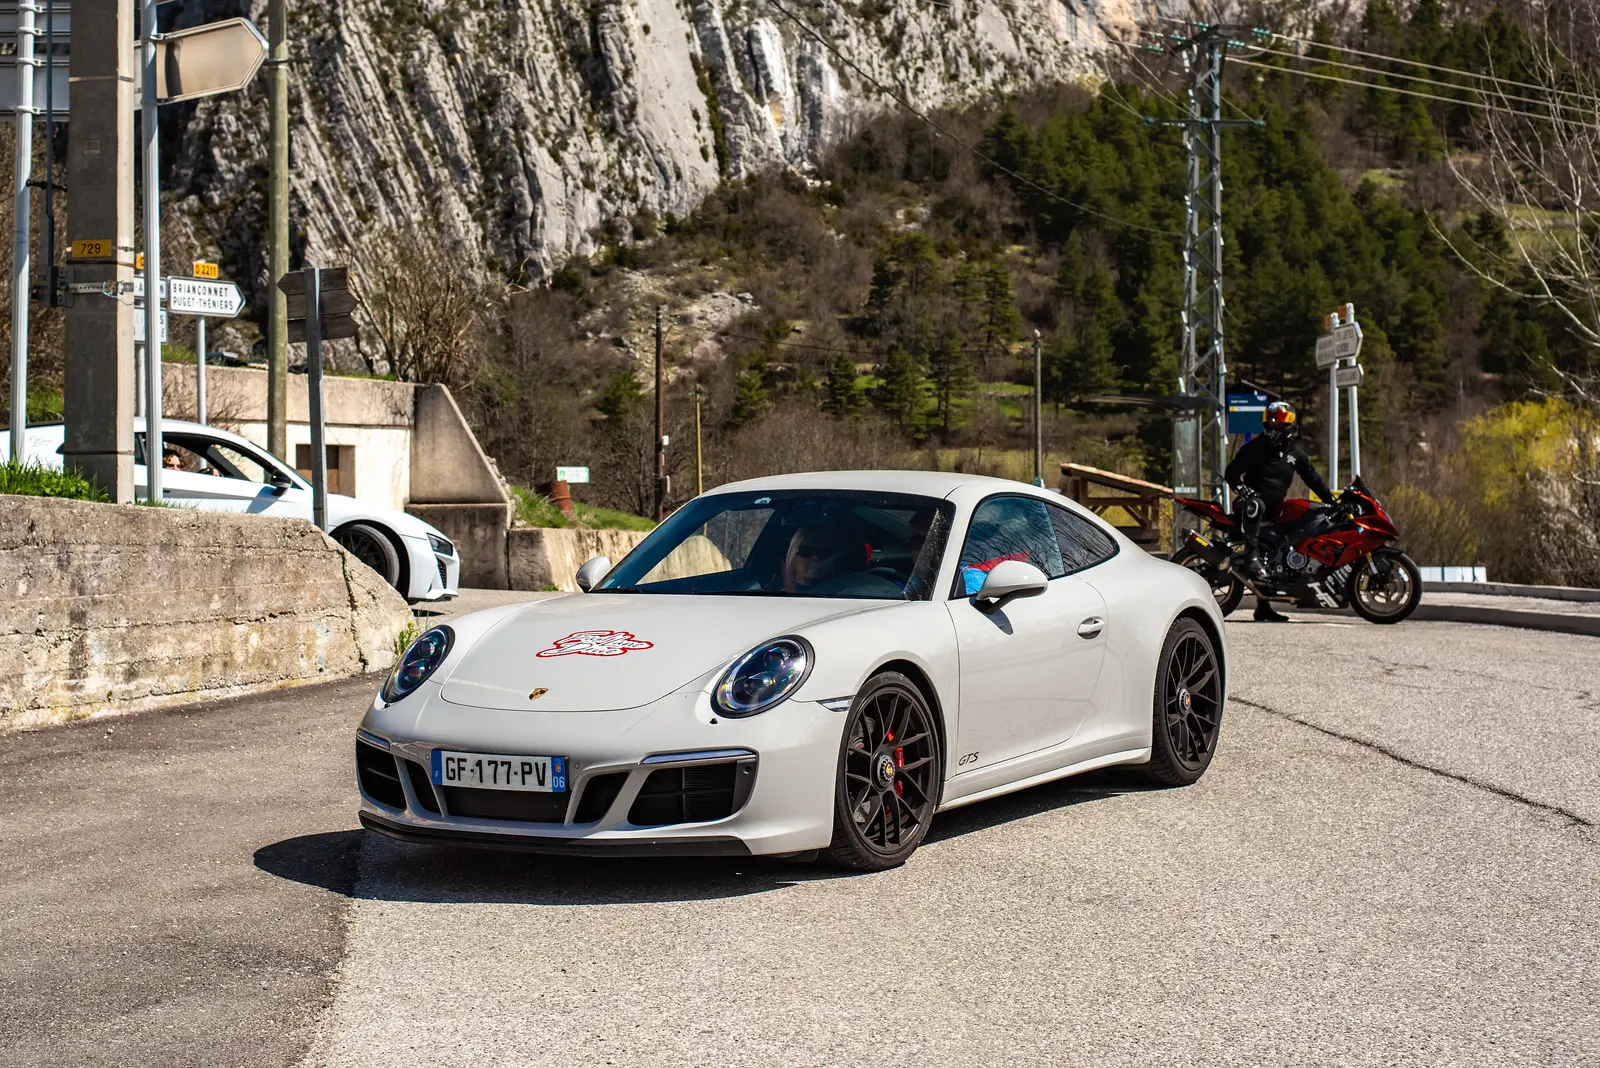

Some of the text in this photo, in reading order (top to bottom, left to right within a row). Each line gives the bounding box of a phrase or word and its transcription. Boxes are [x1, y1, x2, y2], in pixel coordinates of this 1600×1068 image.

[80, 243, 102, 254] 729
[195, 264, 217, 276] D 2211
[959, 751, 979, 766] GTS
[434, 757, 565, 788] F GF-177-PV 06
